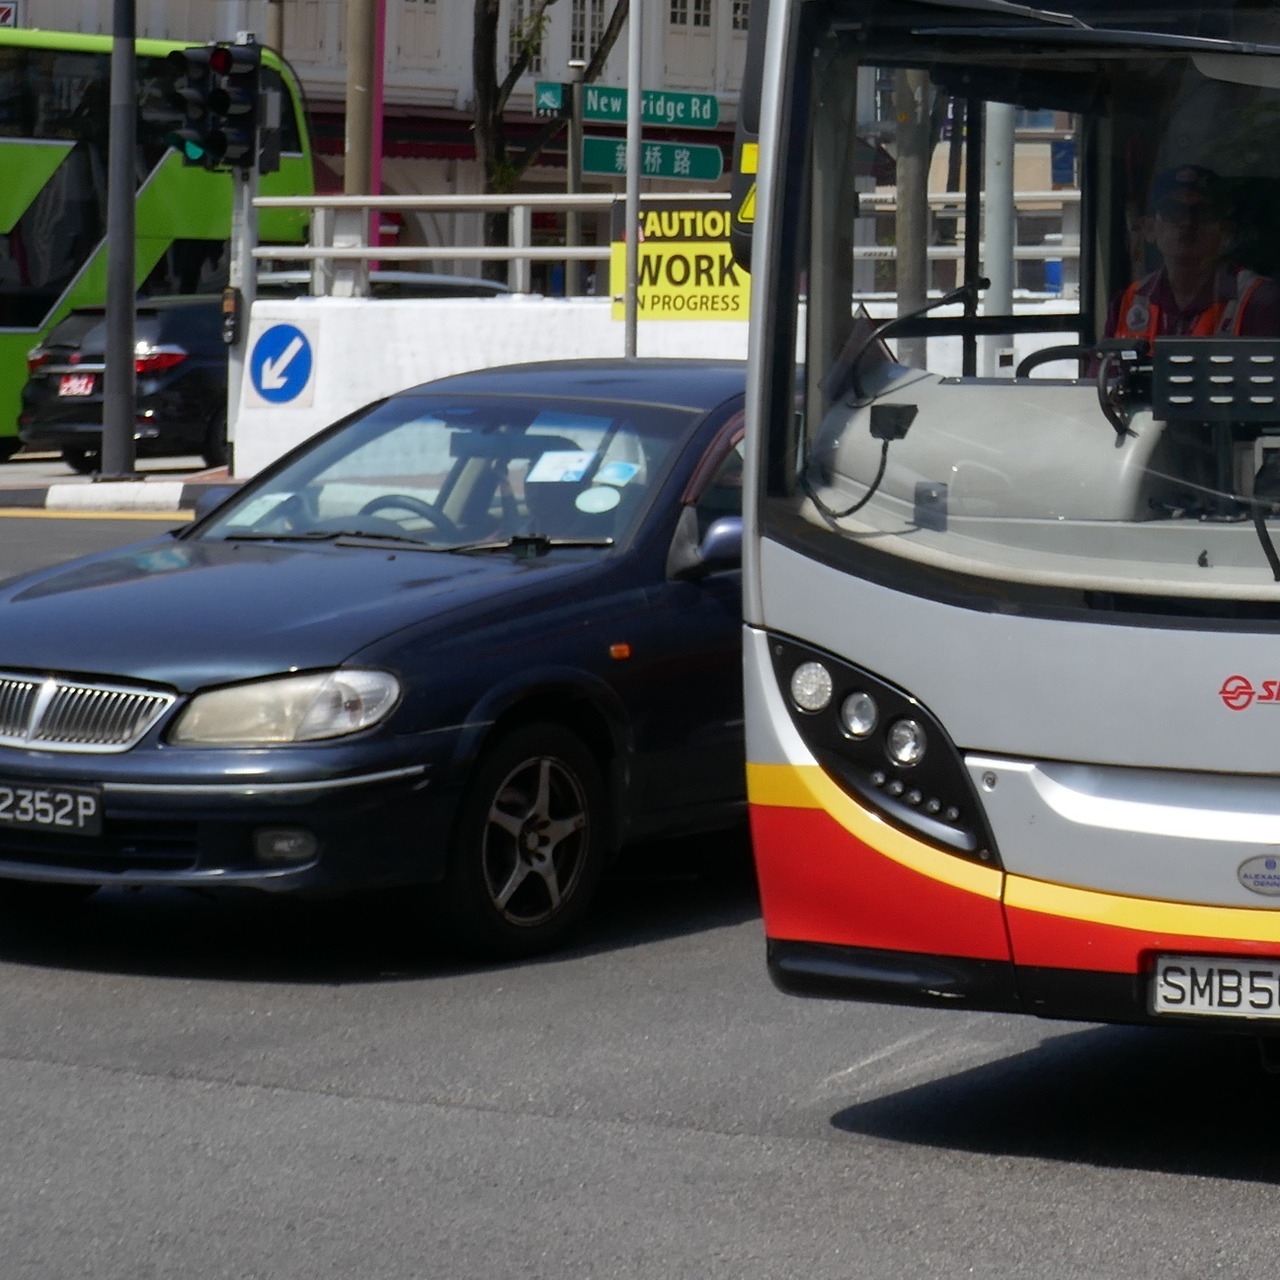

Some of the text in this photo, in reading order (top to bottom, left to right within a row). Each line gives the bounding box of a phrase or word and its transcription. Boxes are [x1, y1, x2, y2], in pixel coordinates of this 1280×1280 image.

[587, 89, 712, 123] New ridge Rd
[638, 210, 731, 238] AUTIO
[637, 254, 740, 287] WORK
[651, 294, 740, 312] PROGRESS
[0, 786, 96, 828] 2352P
